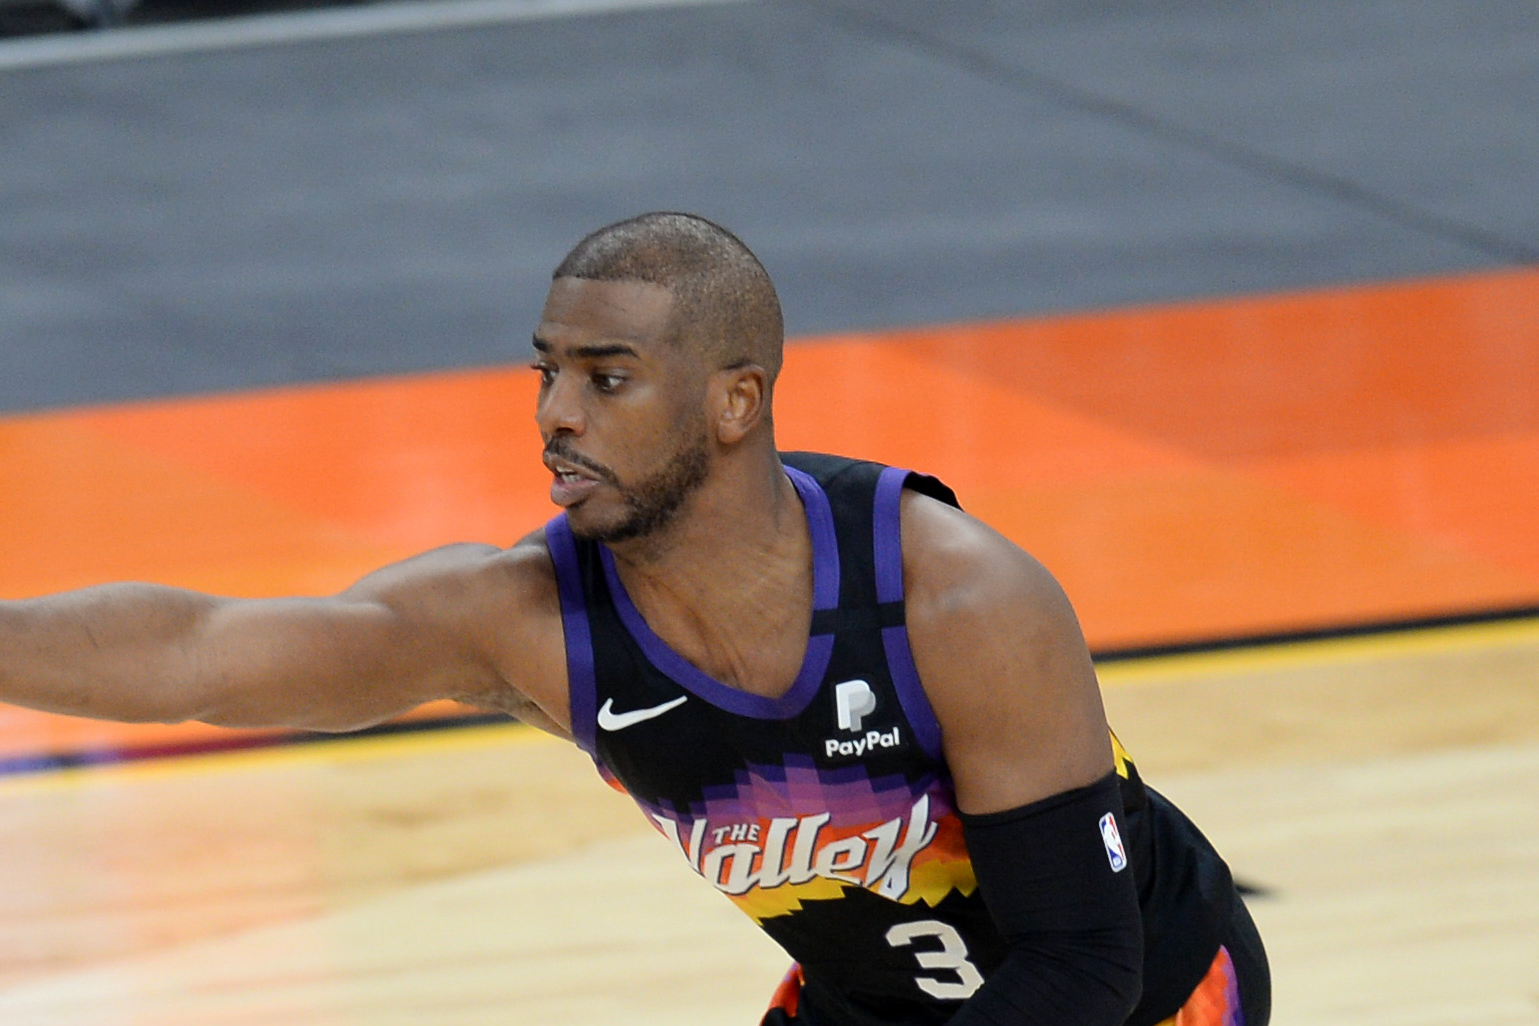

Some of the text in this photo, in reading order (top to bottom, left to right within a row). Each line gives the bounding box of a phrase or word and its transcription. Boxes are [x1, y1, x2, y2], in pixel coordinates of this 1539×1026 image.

[825, 726, 901, 758] PayPal
[652, 793, 939, 903] THE Valley
[885, 919, 986, 1000] 3
